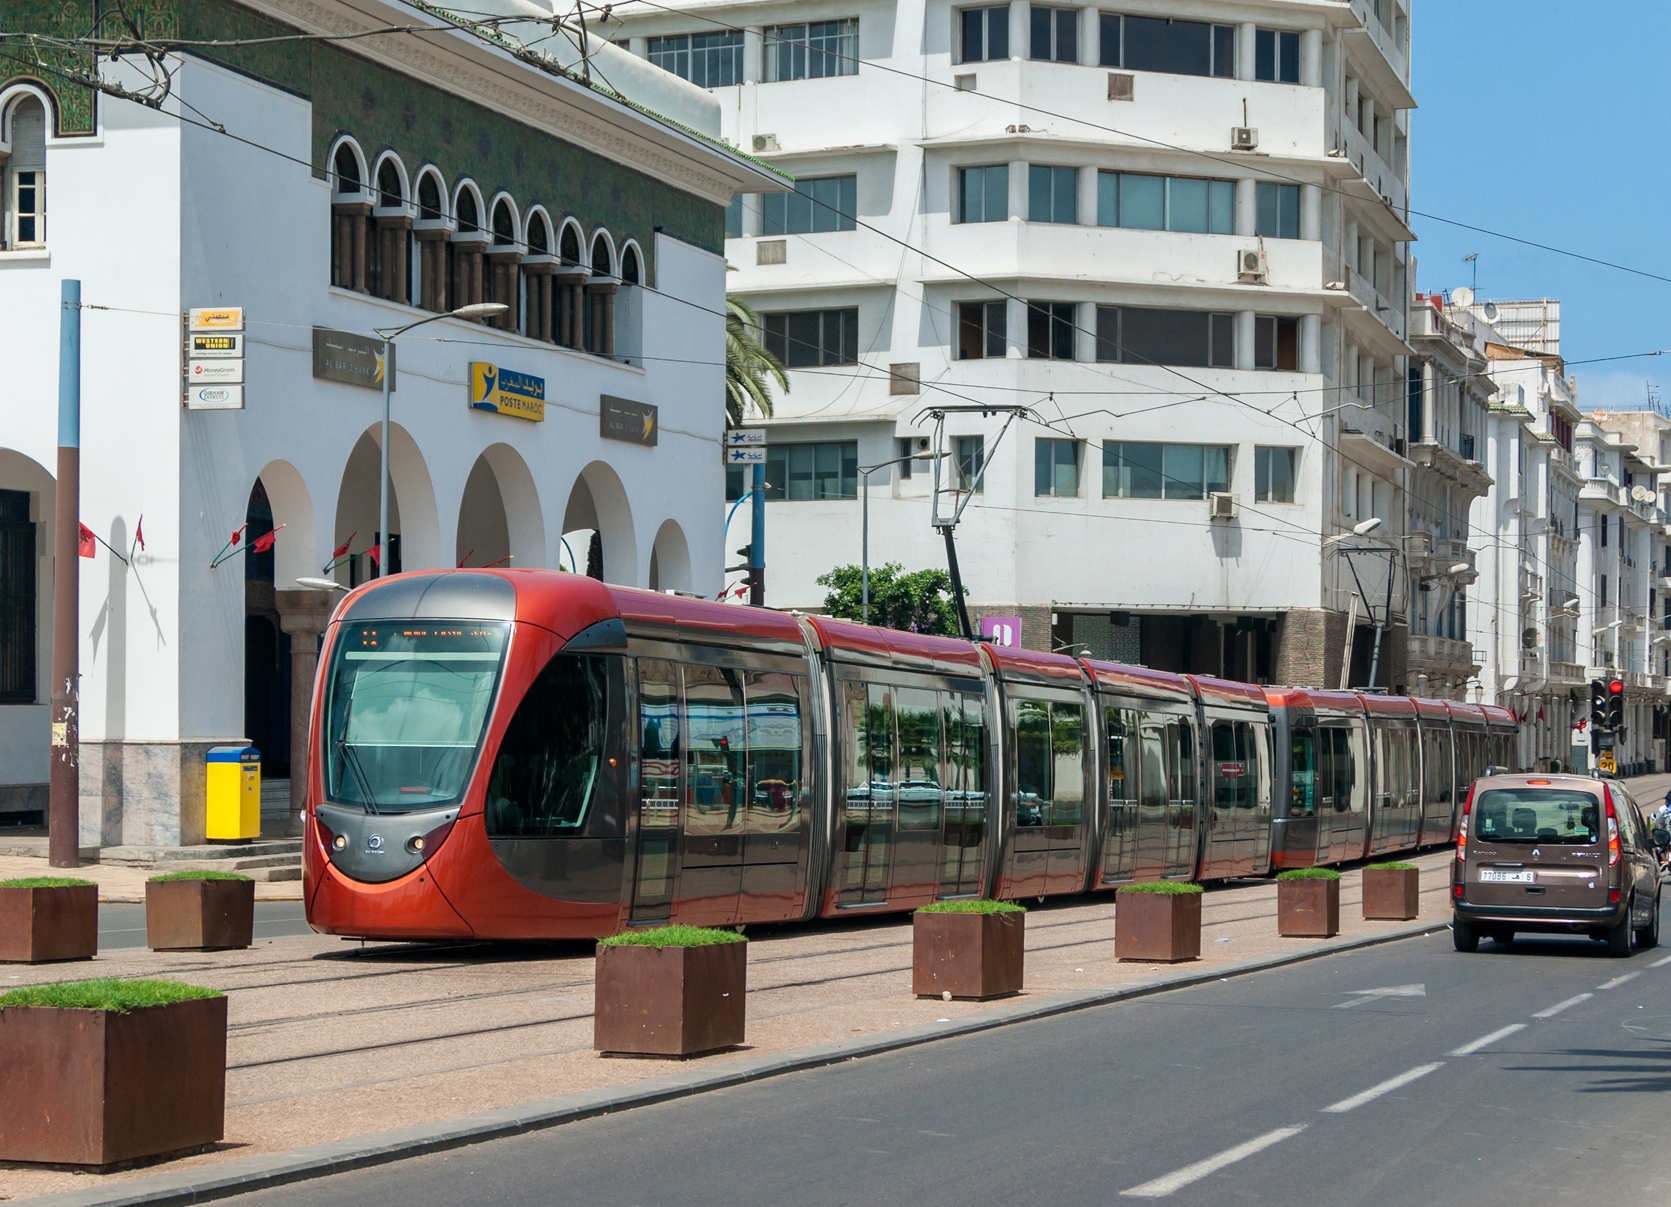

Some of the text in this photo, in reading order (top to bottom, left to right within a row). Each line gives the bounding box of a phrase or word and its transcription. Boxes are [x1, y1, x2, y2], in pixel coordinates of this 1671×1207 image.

[501, 374, 543, 396] بريد المغرب
[500, 396, 542, 414] POSTE MAROC
[1602, 762, 1614, 770] 20
